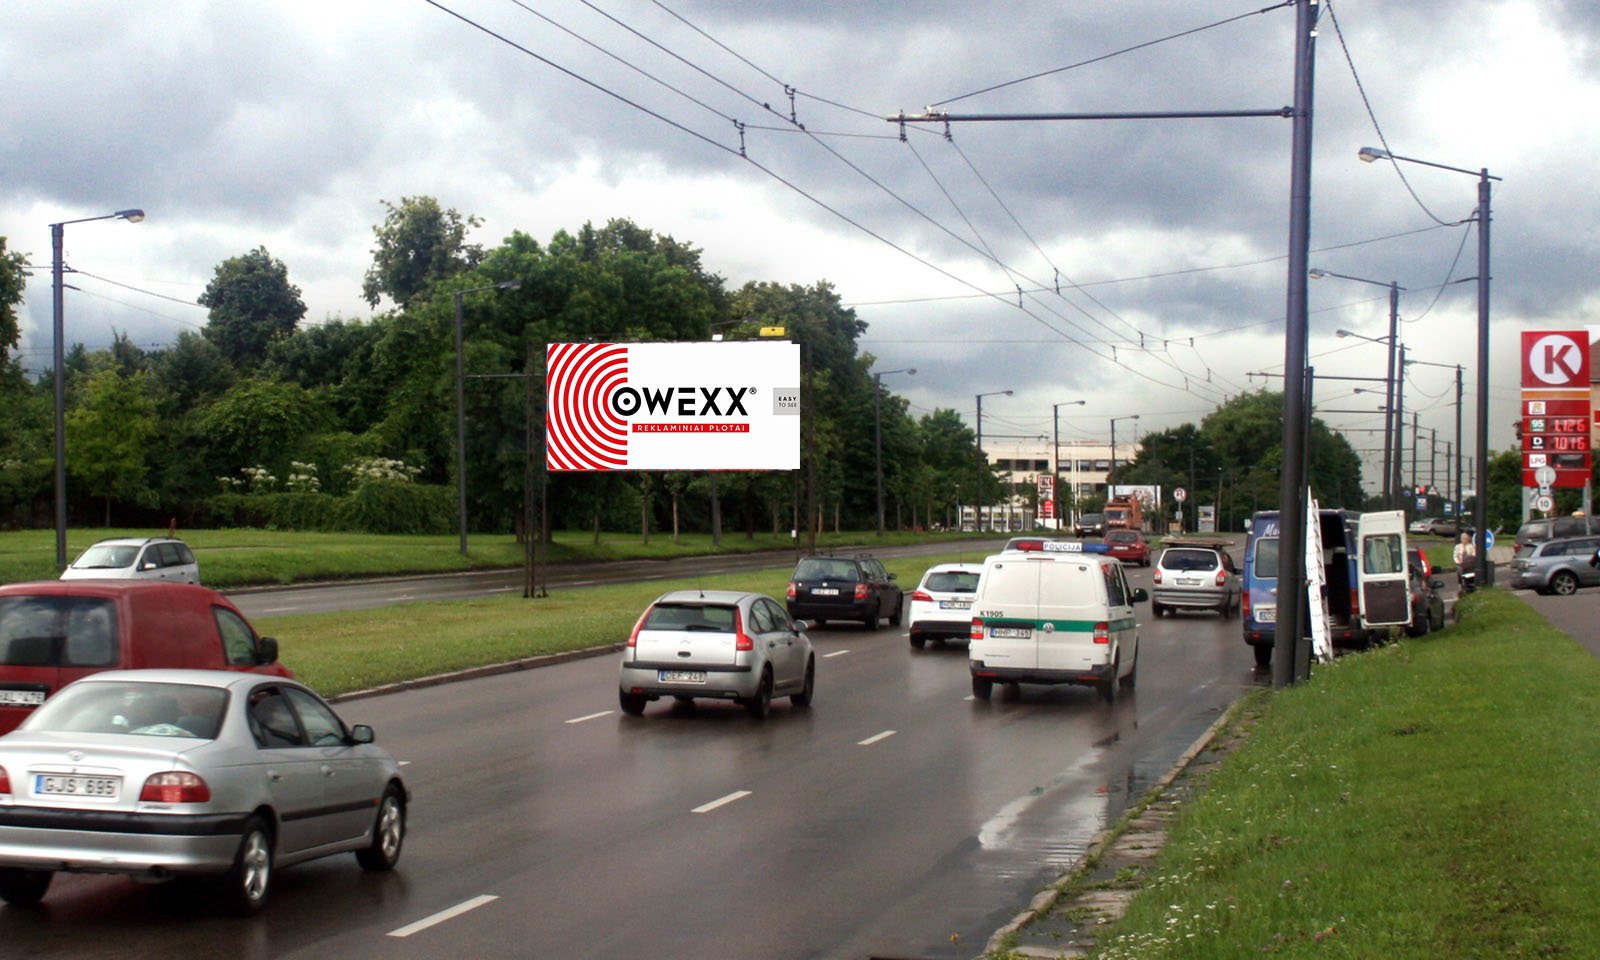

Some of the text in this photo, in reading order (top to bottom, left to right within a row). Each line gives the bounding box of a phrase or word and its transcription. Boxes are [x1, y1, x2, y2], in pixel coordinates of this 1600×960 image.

[1544, 344, 1576, 381] K
[1531, 419, 1544, 428] 95
[637, 424, 745, 432] REKLAMINIAI PLOTAI
[1532, 437, 1543, 445] D
[1540, 500, 1549, 508] 10
[44, 777, 115, 795] GJS 695
